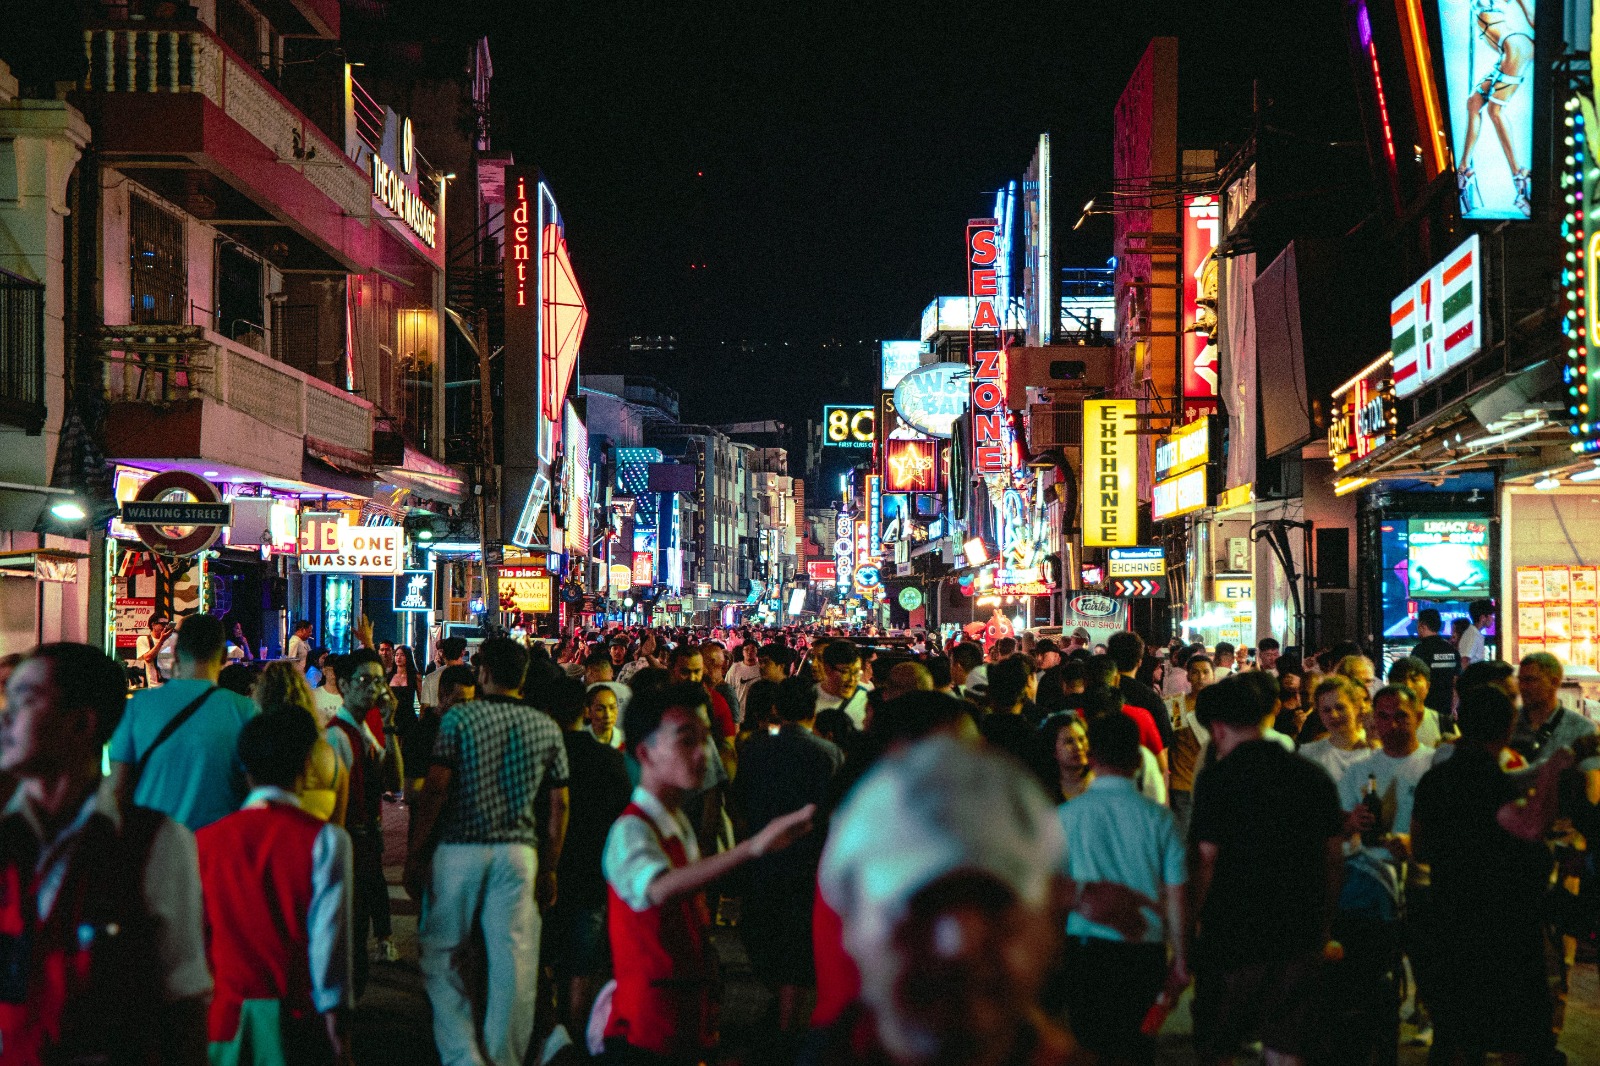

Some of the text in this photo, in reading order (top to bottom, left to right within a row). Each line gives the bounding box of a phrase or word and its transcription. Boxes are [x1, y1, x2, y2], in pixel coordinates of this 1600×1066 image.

[374, 154, 436, 249] THE ONE MASSAGE
[513, 177, 529, 306] identi
[972, 230, 998, 328] SEA
[974, 350, 1001, 472] ZONE
[892, 455, 932, 469] STARS
[1100, 405, 1118, 541] EXCHANGE
[128, 507, 222, 519] WALKING STREET
[309, 555, 393, 566] MASSAGE
[353, 537, 394, 551] ONE
[1066, 619, 1121, 630] BOXING SHOW
